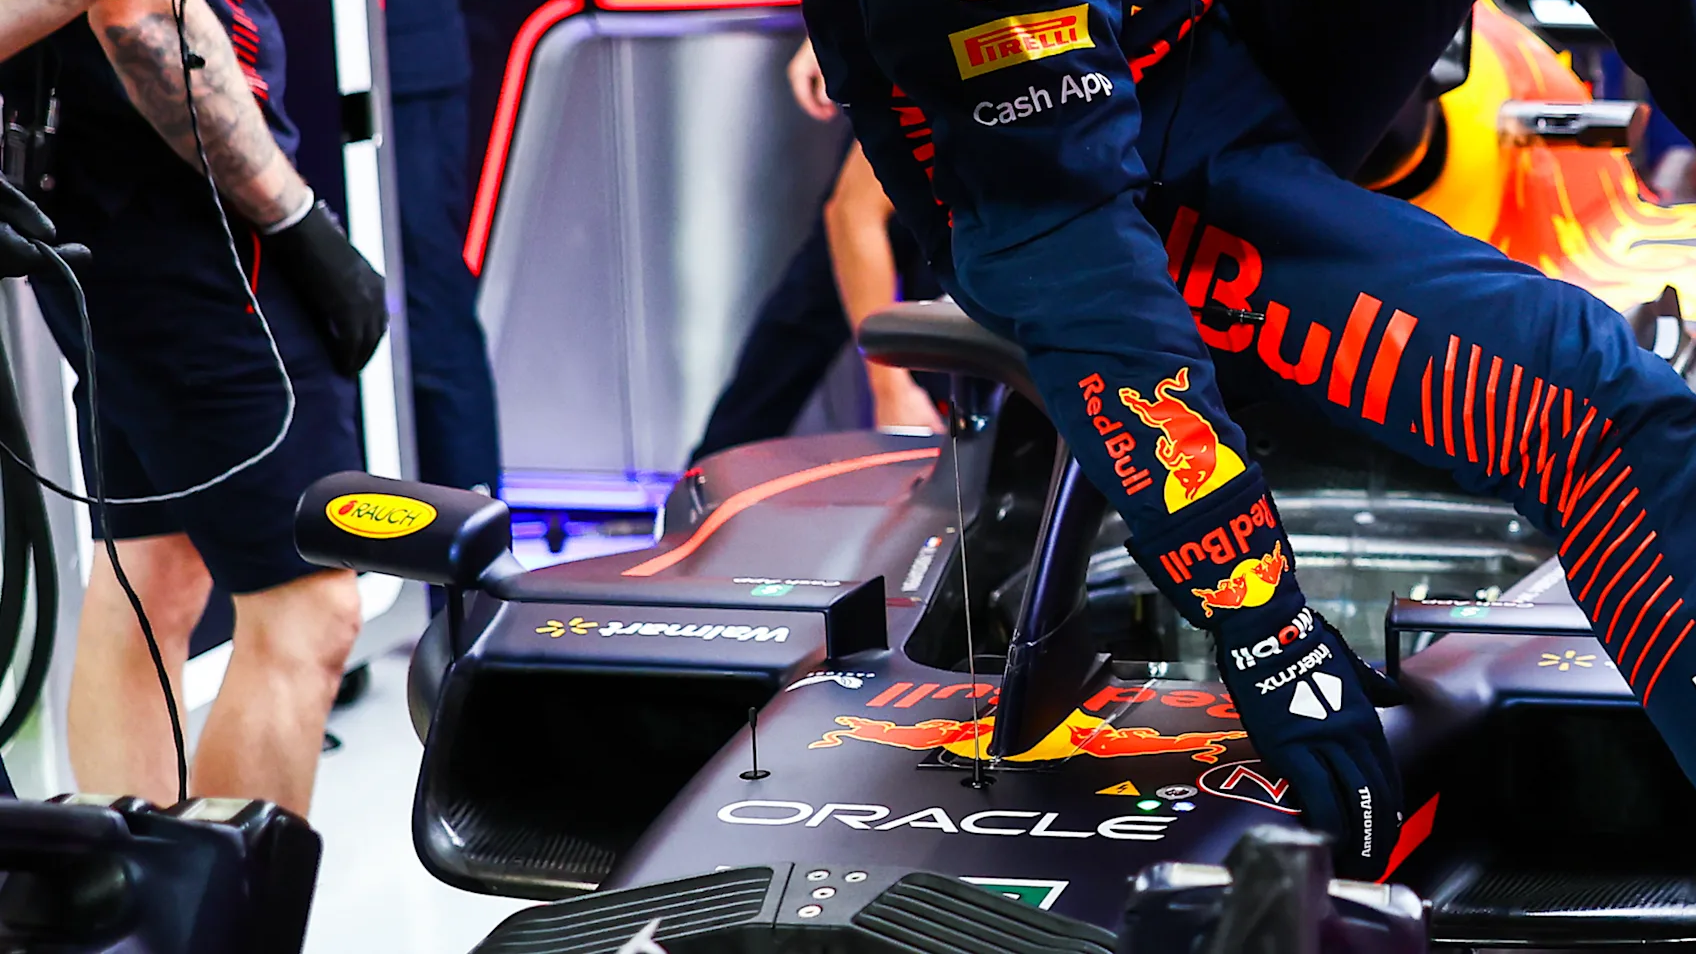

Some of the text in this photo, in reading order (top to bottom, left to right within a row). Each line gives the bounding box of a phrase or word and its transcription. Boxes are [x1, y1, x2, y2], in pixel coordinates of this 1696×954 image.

[962, 14, 1078, 68] PIRELLI
[973, 70, 1114, 127] Cash App
[1182, 223, 1419, 426] Bull
[1078, 372, 1153, 496] Red Bull
[350, 502, 422, 527] RAUCH
[1159, 494, 1277, 585] Red Bull
[598, 620, 790, 644] Walmart
[1231, 607, 1317, 671] Mobil
[1255, 643, 1334, 695] inter.mx
[866, 682, 1242, 720] Red ull
[717, 799, 1179, 841] ORACLE
